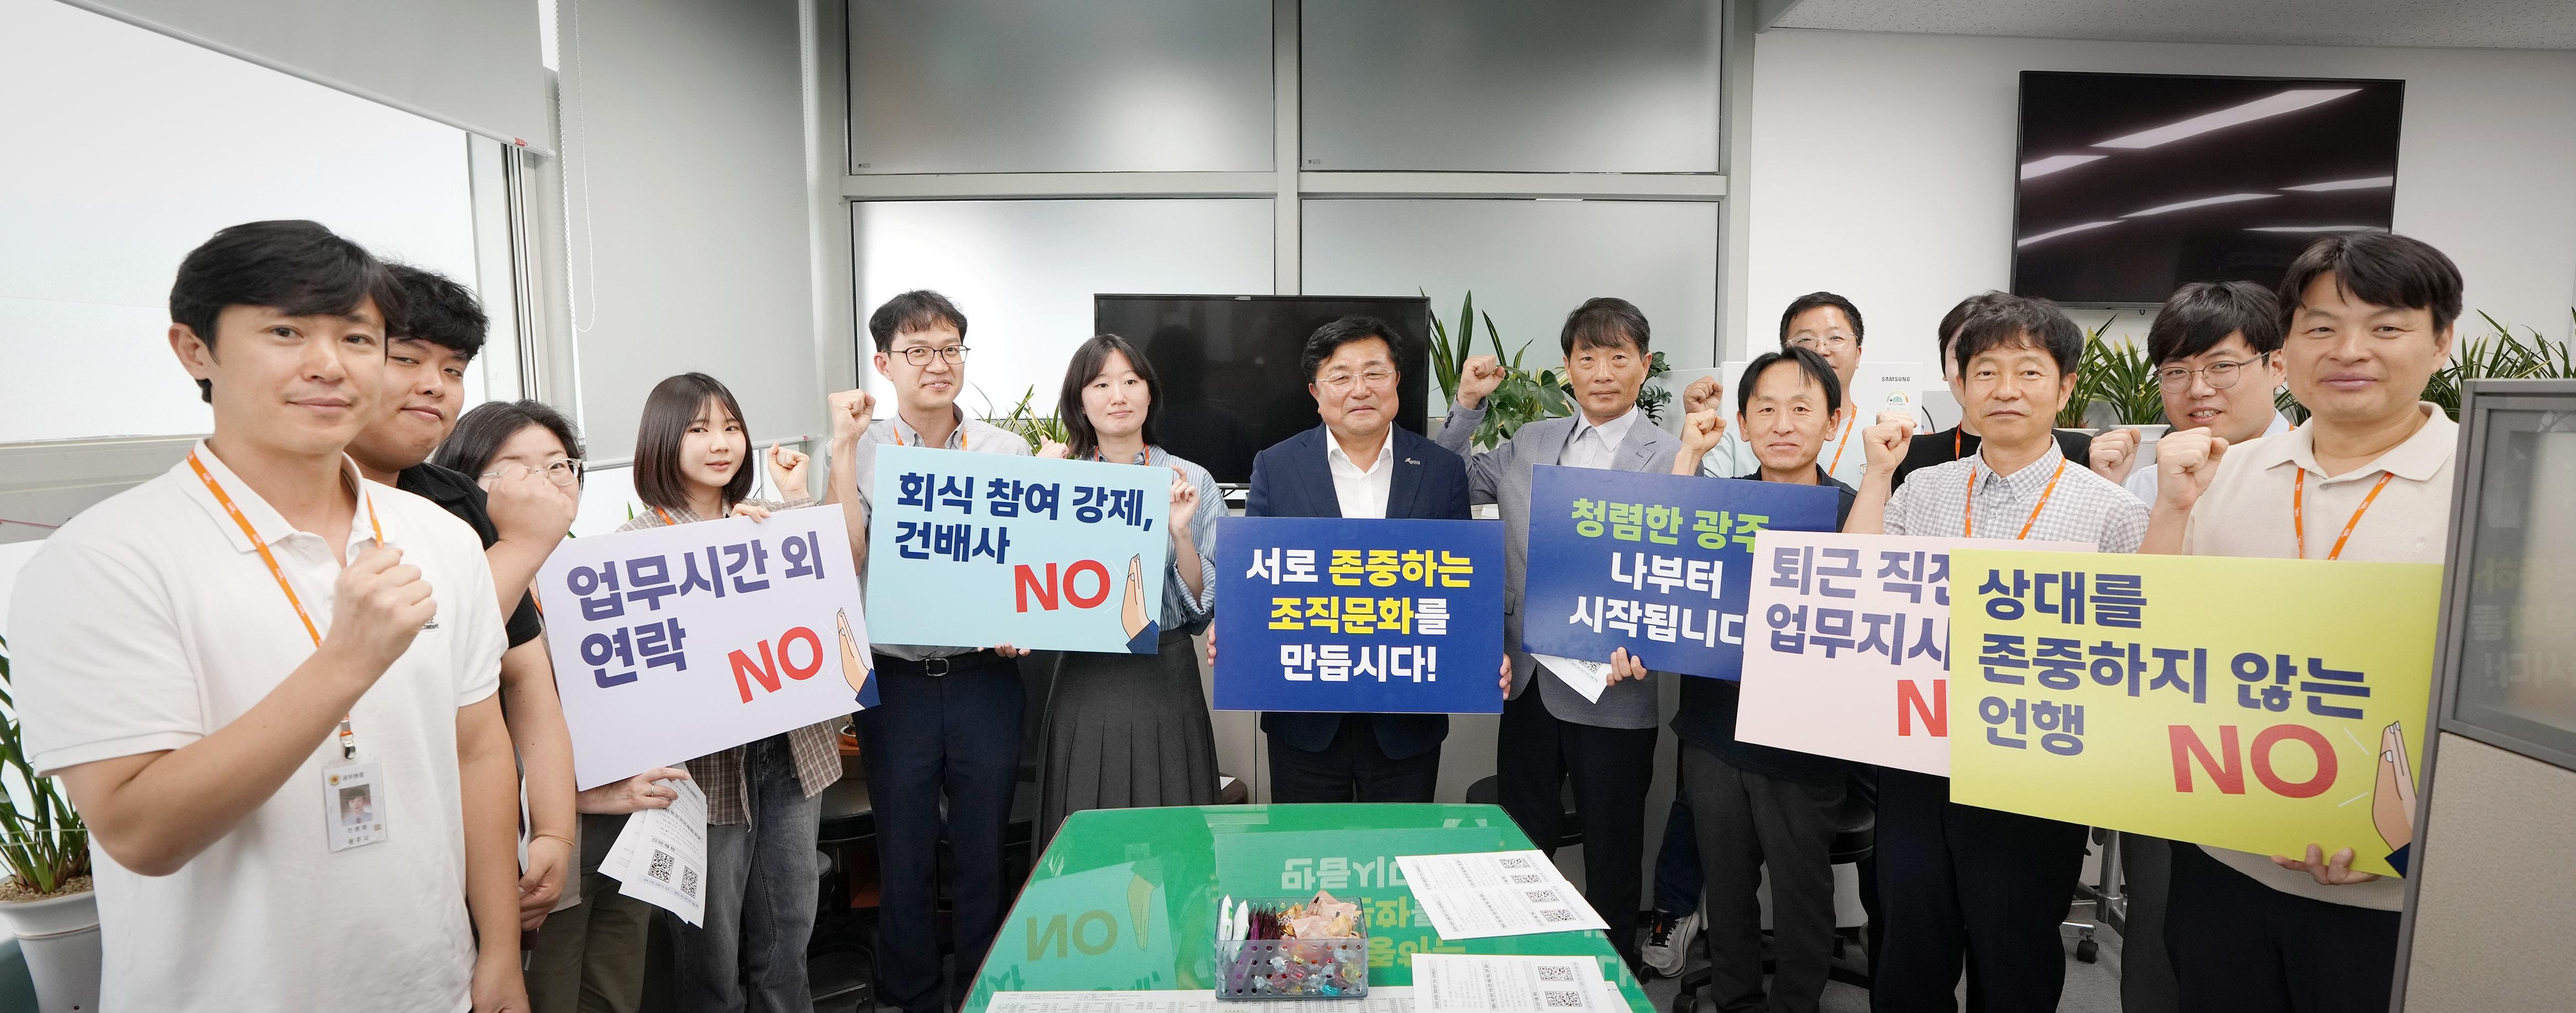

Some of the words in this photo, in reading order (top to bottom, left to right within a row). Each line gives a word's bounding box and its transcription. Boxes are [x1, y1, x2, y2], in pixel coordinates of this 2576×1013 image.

[897, 472, 974, 515] 회식
[986, 478, 1060, 521] 참여
[1072, 486, 1153, 532] 강제,
[1571, 498, 1683, 545] 청렴한
[895, 521, 1011, 565] 건배사
[1246, 547, 1319, 585] 서로
[1328, 549, 1473, 588] 존중하는
[567, 540, 770, 621] 업무시간
[782, 531, 825, 579] 외
[1014, 559, 1111, 613] NO
[1611, 552, 1723, 599] 나부터
[1770, 546, 1862, 599] 퇴근
[1978, 569, 2147, 629] 상대를
[1268, 596, 1450, 635] 조직문화를
[581, 617, 687, 689] 연락
[728, 626, 823, 704] NO
[1280, 644, 1436, 682] 만듭시다!
[1978, 633, 2207, 704] 존중하지
[2231, 652, 2371, 720] 않는
[1897, 679, 1948, 737] N
[1978, 696, 2085, 756] 언행
[2168, 724, 2338, 799] NO
